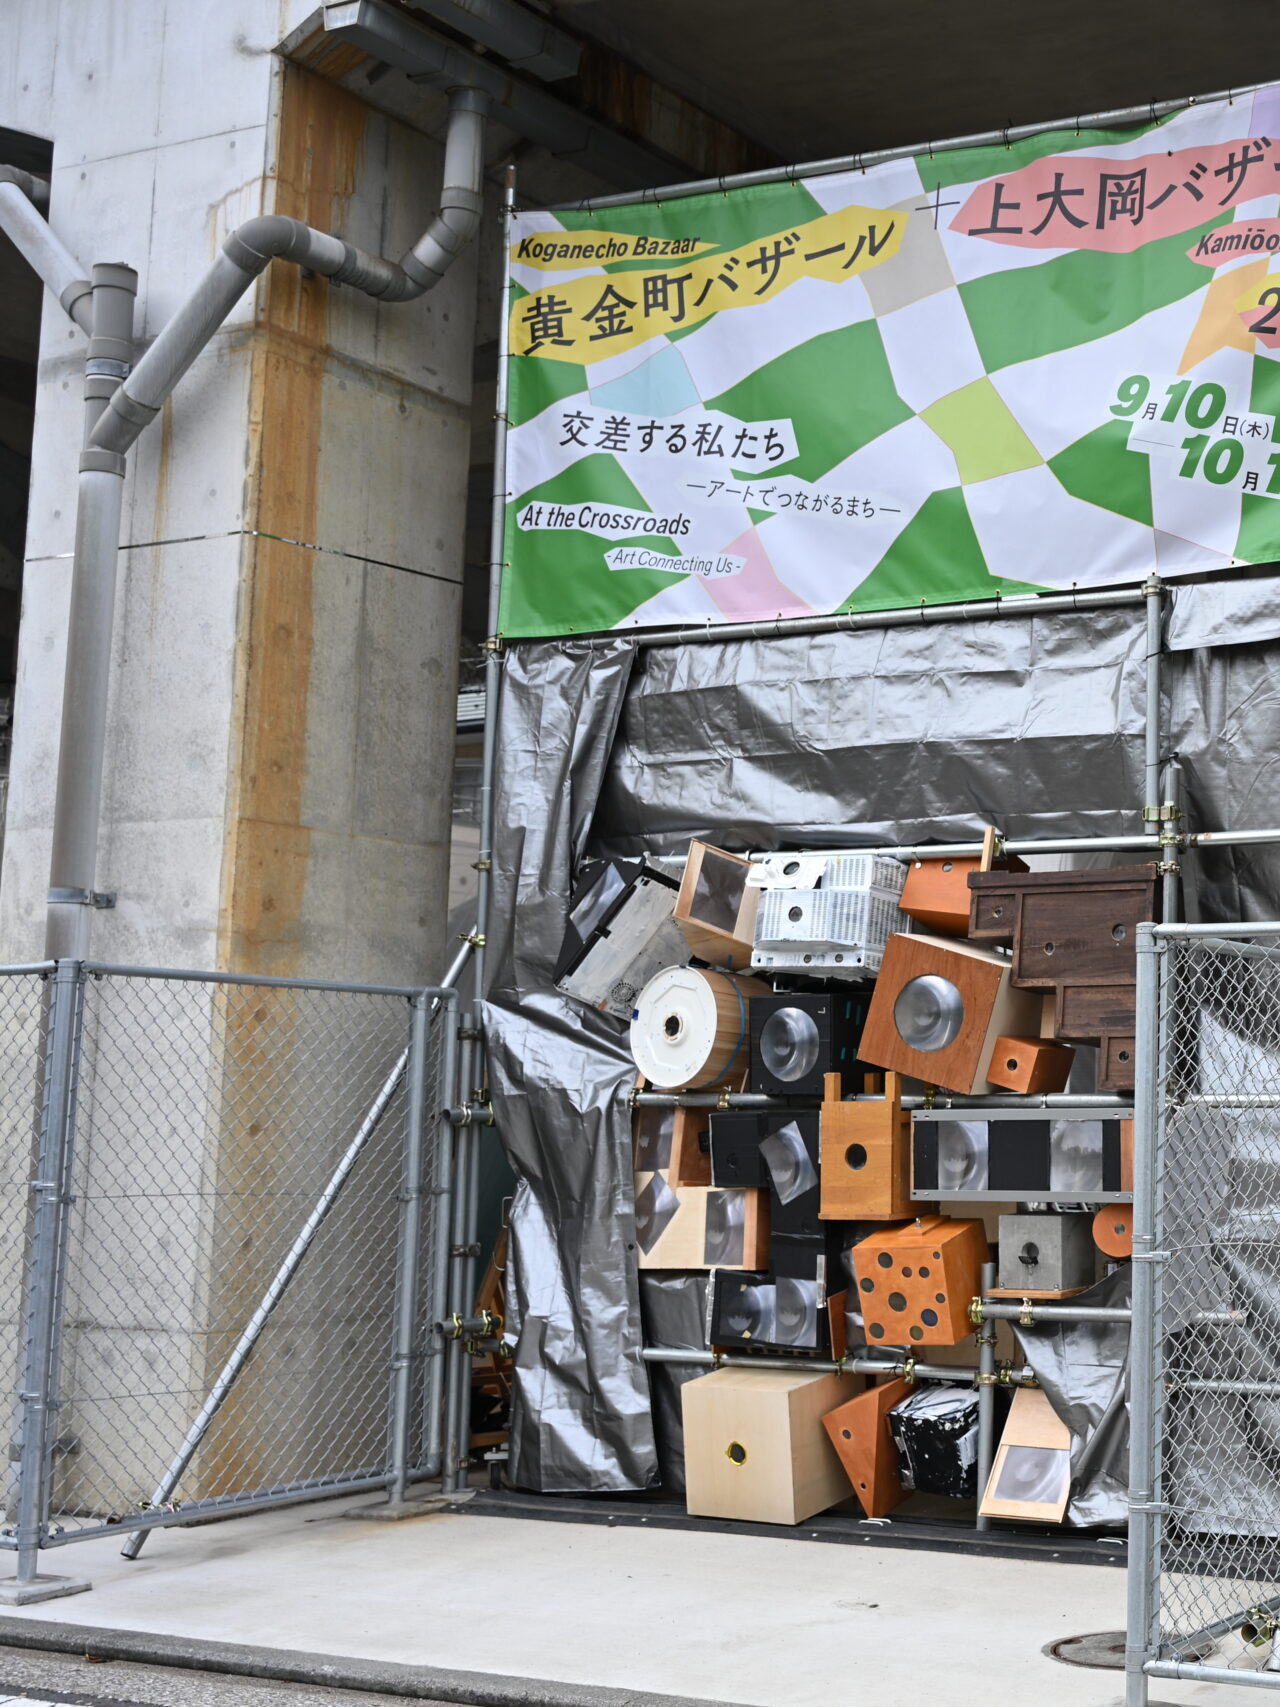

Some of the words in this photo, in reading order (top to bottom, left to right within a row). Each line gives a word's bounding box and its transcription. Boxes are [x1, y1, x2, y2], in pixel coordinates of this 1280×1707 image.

[517, 237, 628, 262] Koganecho
[632, 235, 700, 257] Bazaar
[521, 220, 895, 356] 黄金町バザール
[559, 410, 786, 461] 交差する私たち
[521, 505, 544, 527] At
[546, 506, 576, 528] the
[578, 506, 691, 535] Crossroads
[612, 549, 636, 565] Art
[638, 551, 713, 576] Connecting
[715, 558, 734, 574] Us
